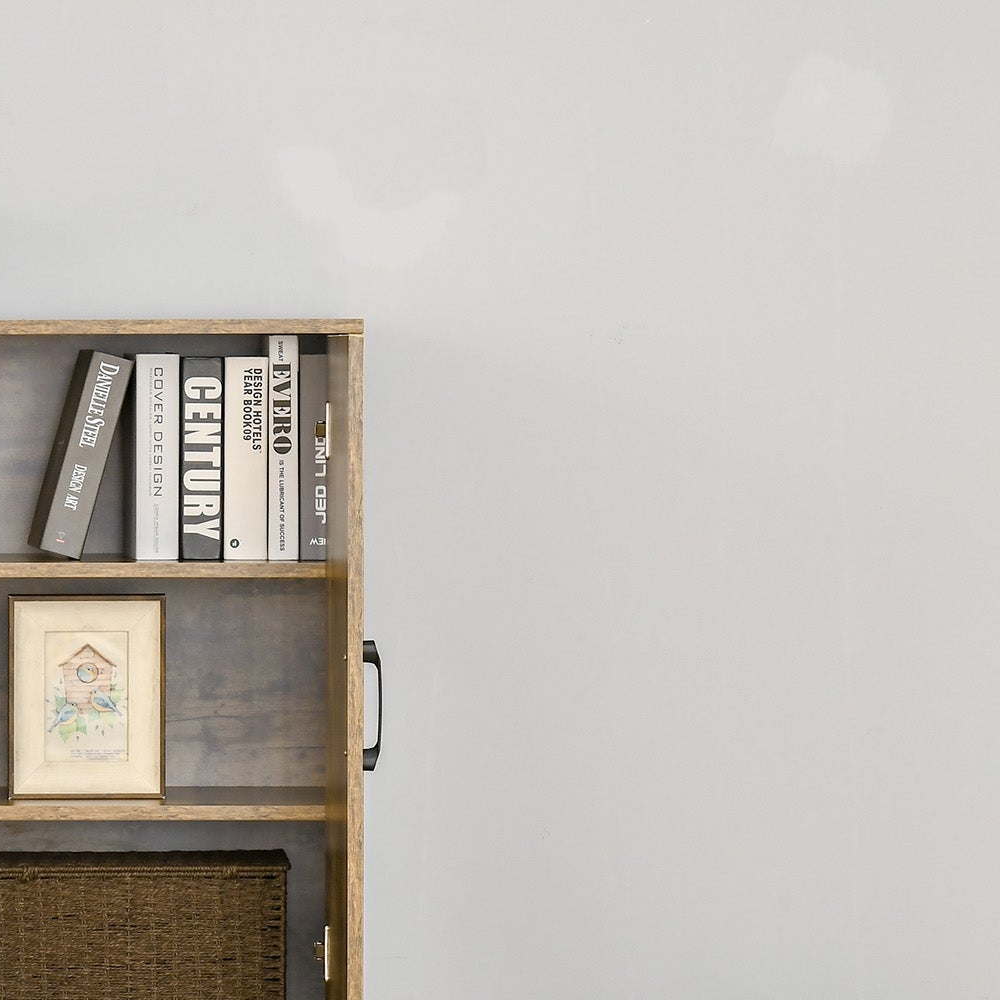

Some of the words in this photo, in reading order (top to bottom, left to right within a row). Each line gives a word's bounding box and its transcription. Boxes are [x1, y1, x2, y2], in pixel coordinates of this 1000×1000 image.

[87, 361, 120, 416] DANIELLE
[153, 367, 164, 424] COVER
[243, 368, 253, 395] YEAR
[252, 368, 263, 407] DESIGN
[272, 362, 293, 455] EVERO
[78, 415, 105, 448] STEEL
[153, 431, 164, 497] DESIGN
[183, 376, 223, 540] CENTURY
[68, 464, 87, 493] DESIGN
[63, 493, 78, 511] ART
[279, 513, 285, 522] OF
[314, 485, 327, 524] JED
